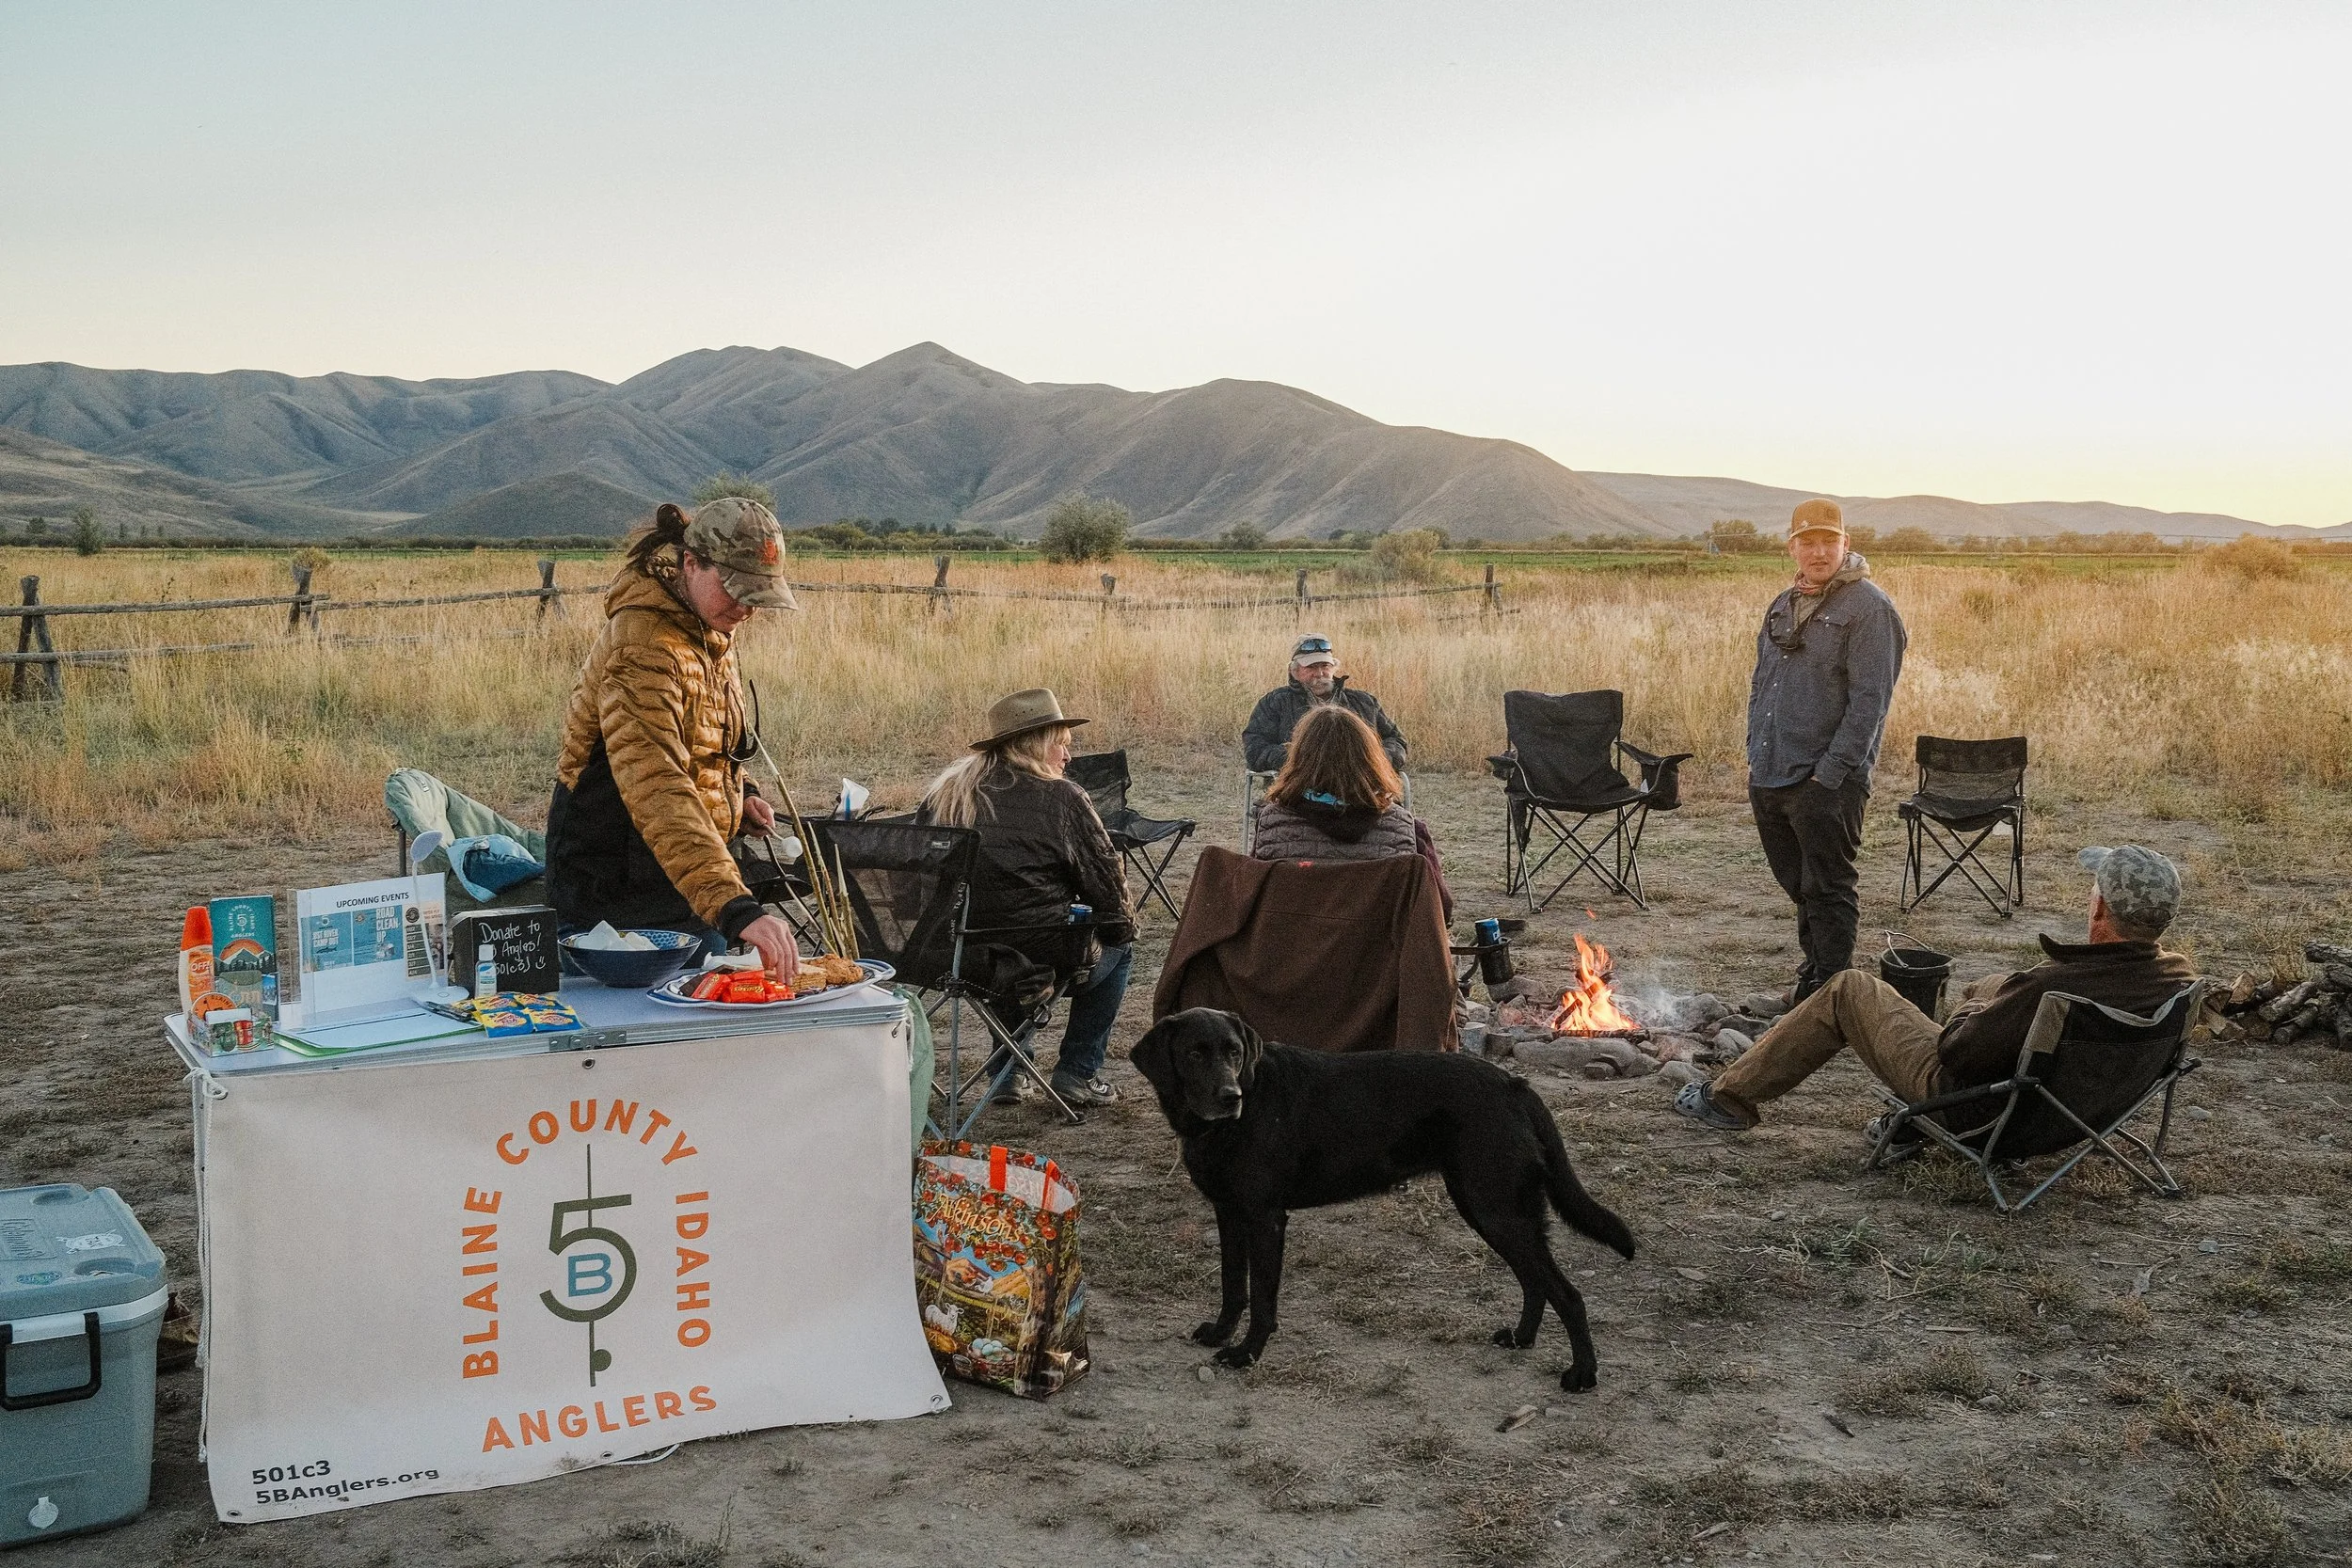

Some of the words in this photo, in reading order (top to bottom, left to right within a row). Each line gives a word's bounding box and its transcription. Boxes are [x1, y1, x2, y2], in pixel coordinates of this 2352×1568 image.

[336, 895, 379, 909] UPCOMING
[381, 892, 409, 902] EVENTS
[376, 906, 395, 920] ROAD
[376, 930, 387, 943] UP
[478, 922, 523, 943] Donate
[528, 919, 541, 935] to
[463, 1187, 501, 1379] BLAINE
[496, 1099, 697, 1165] COUNTY
[676, 1191, 711, 1348] IDAHO
[483, 1386, 716, 1452] ANGLERS
[252, 1460, 331, 1485] 501c3
[256, 1469, 439, 1504] 5BAnglers.org
